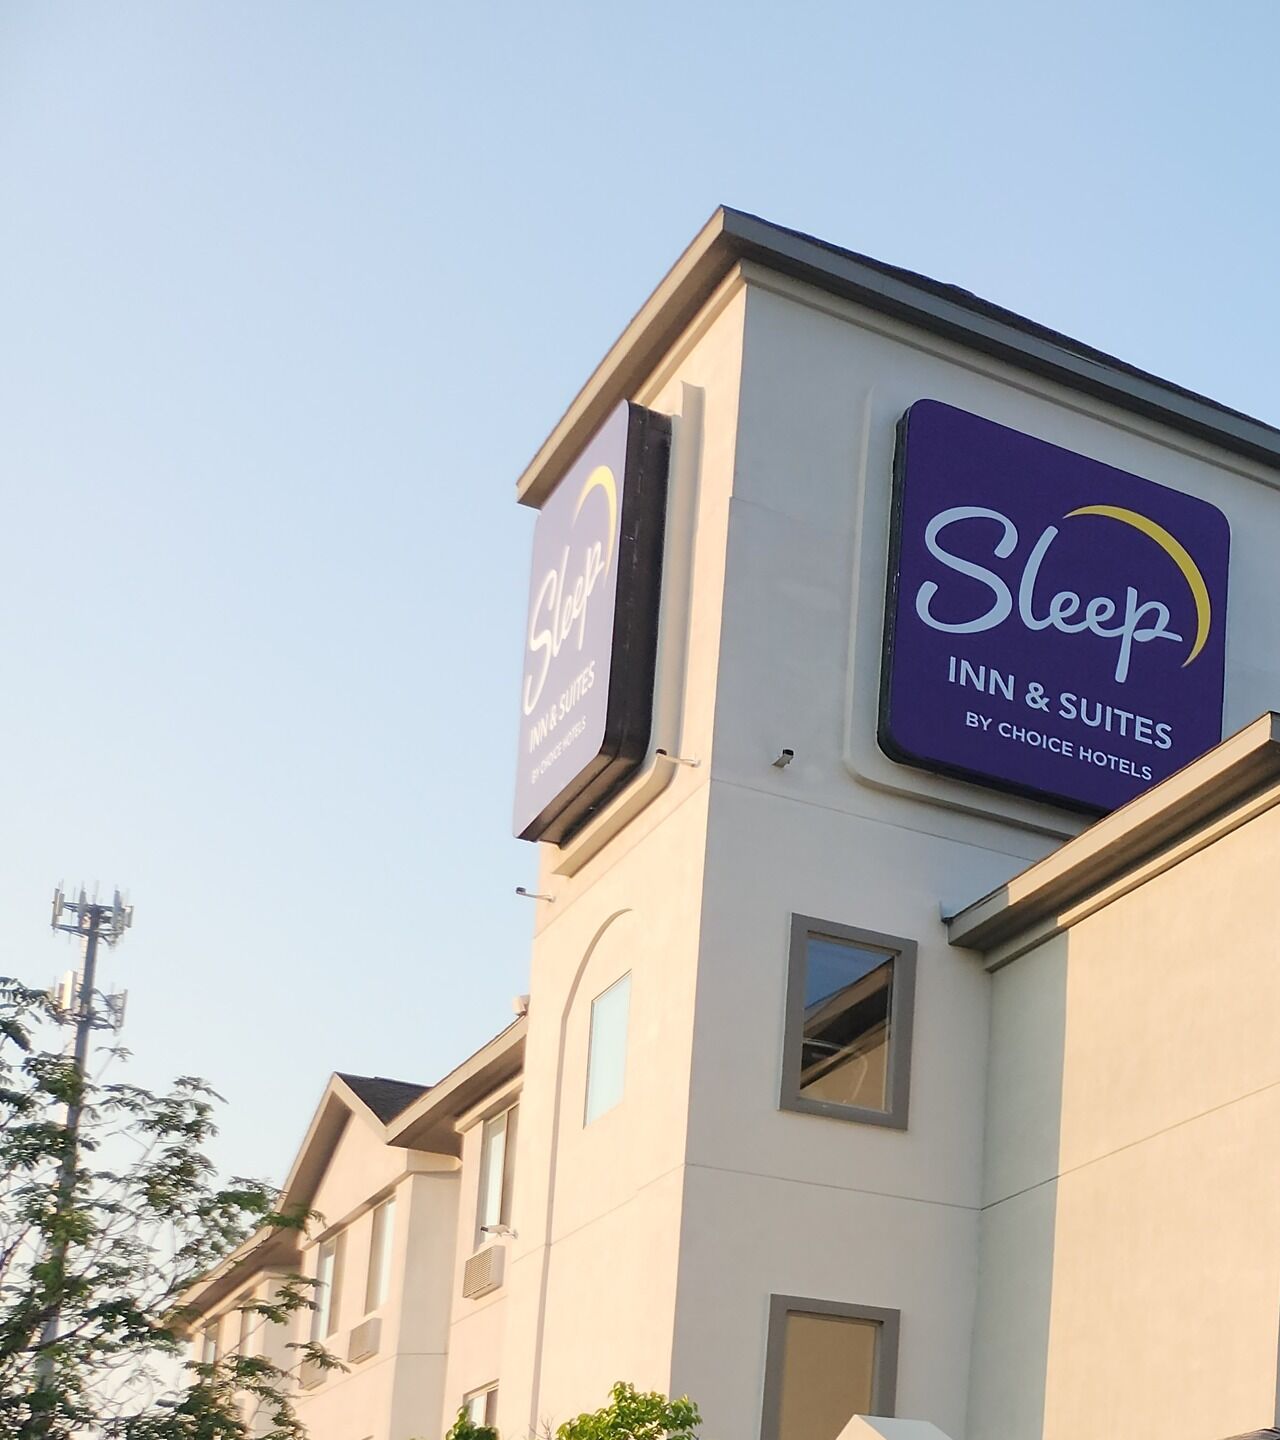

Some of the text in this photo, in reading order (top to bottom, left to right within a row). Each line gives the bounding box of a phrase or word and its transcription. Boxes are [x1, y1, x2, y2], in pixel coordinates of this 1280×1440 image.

[524, 541, 604, 715] Sleep
[915, 506, 1183, 683] Sleep
[529, 660, 595, 754] INN & SUITES
[948, 655, 1173, 750] INN & SUITES
[965, 711, 1152, 781] BY CHOICE HOTELS
